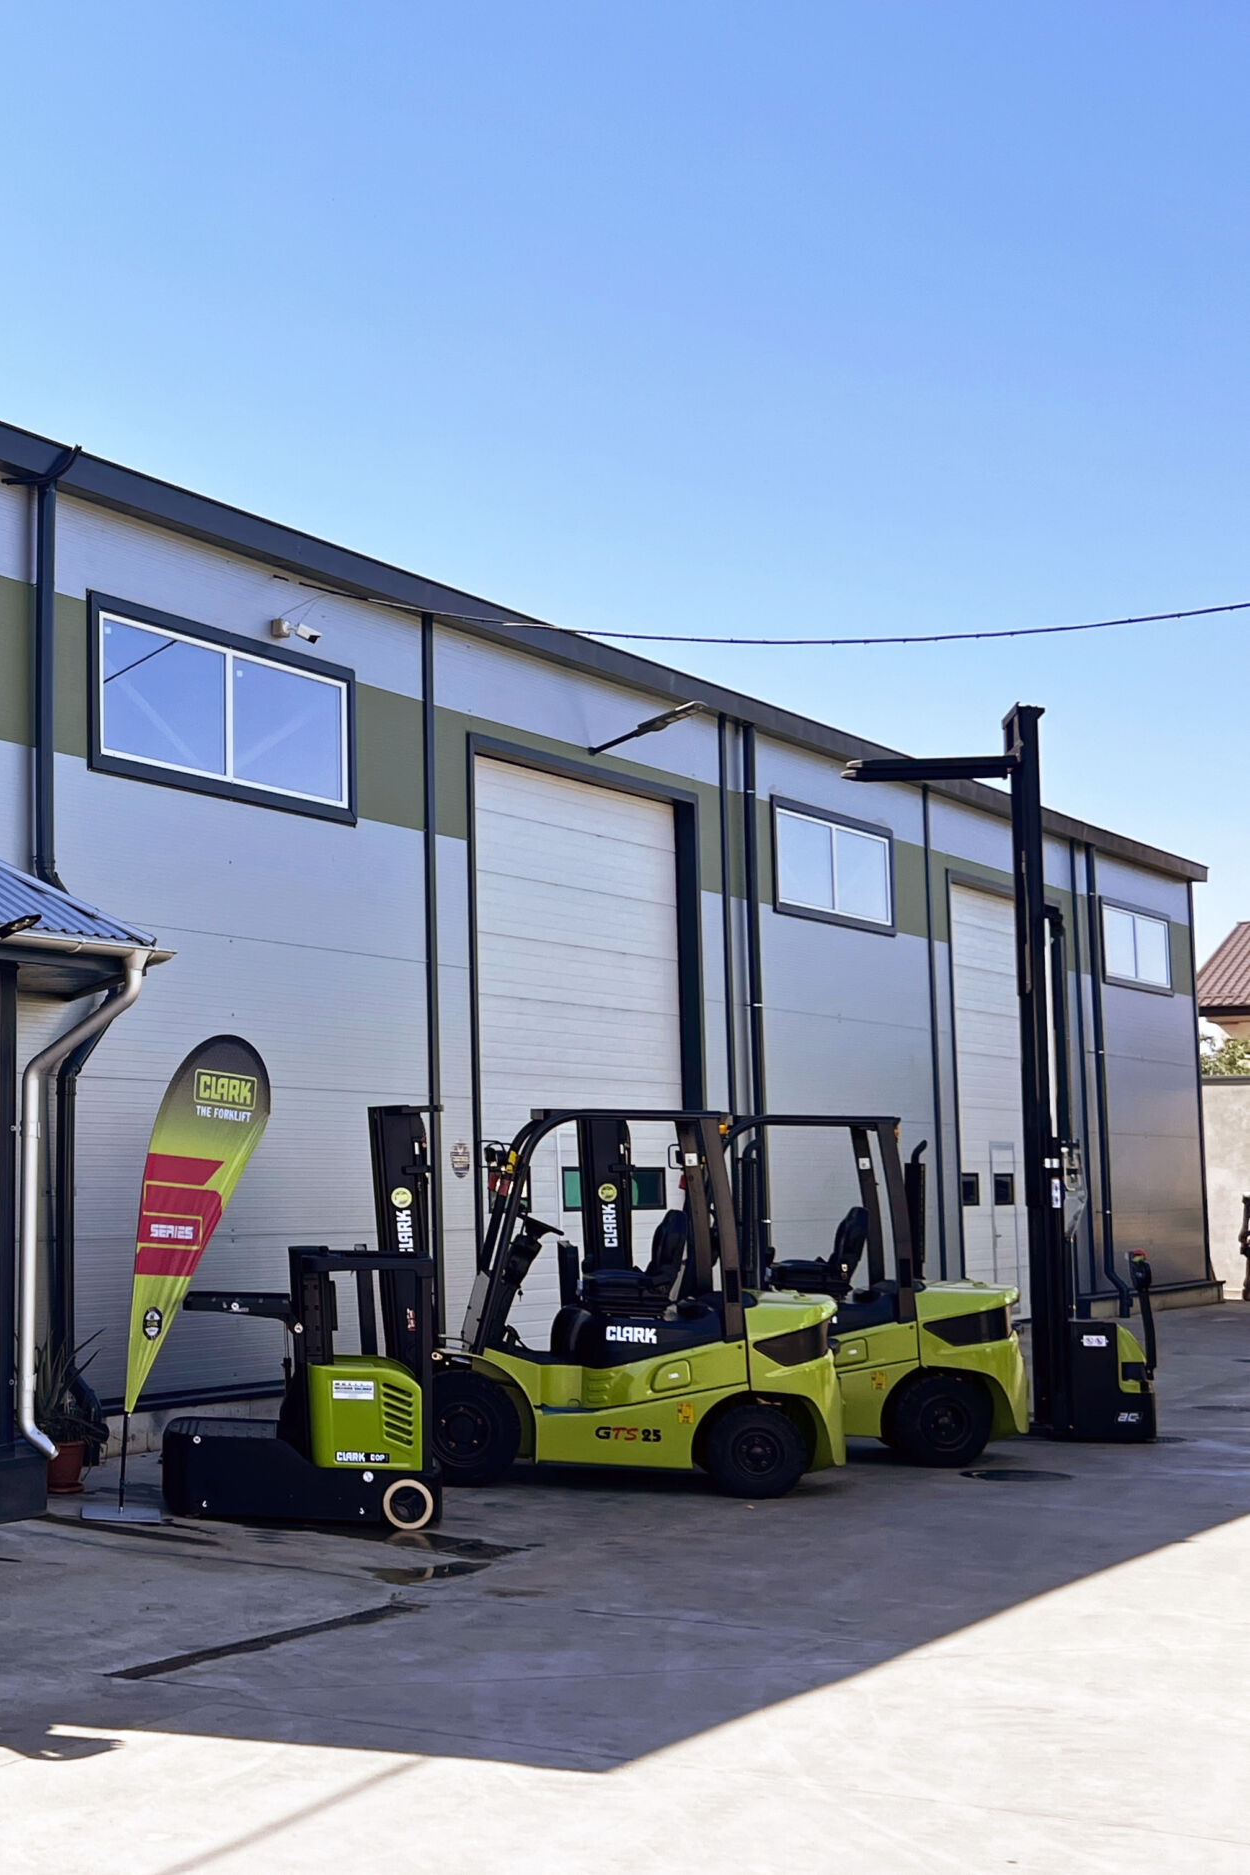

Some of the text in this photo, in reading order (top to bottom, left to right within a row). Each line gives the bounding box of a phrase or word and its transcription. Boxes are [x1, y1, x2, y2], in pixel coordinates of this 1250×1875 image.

[199, 1075, 252, 1105] CLARK
[196, 1105, 252, 1123] THE FORKLIFT
[150, 1223, 194, 1239] SERIES
[601, 1203, 618, 1248] CLARK
[605, 1325, 658, 1345] CLARK
[595, 1426, 662, 1442] GTS 25
[336, 1451, 366, 1462] CLARK
